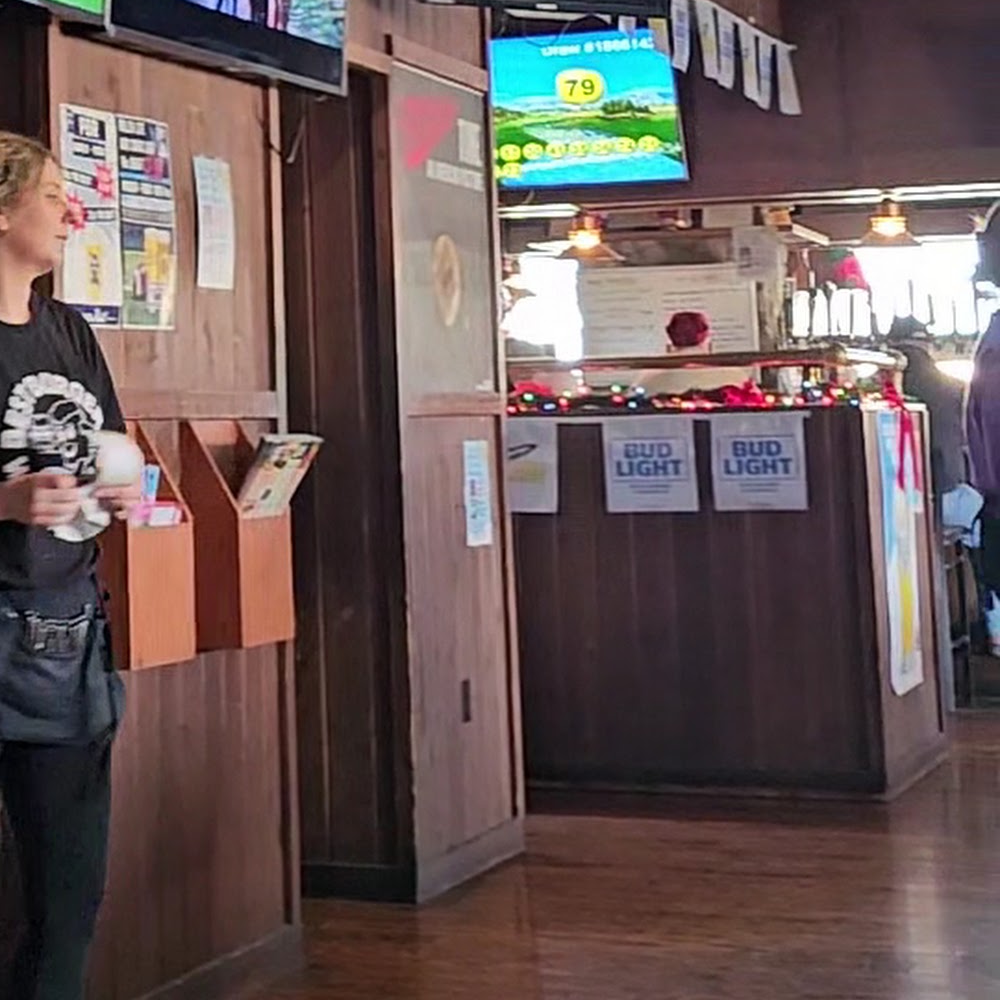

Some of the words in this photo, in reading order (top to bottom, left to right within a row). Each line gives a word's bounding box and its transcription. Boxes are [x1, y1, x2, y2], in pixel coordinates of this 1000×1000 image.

[565, 79, 595, 96] 79
[623, 442, 673, 458] BUD
[732, 440, 782, 457] BUD
[615, 459, 682, 477] LIGHT
[723, 457, 793, 476] LIGHT
